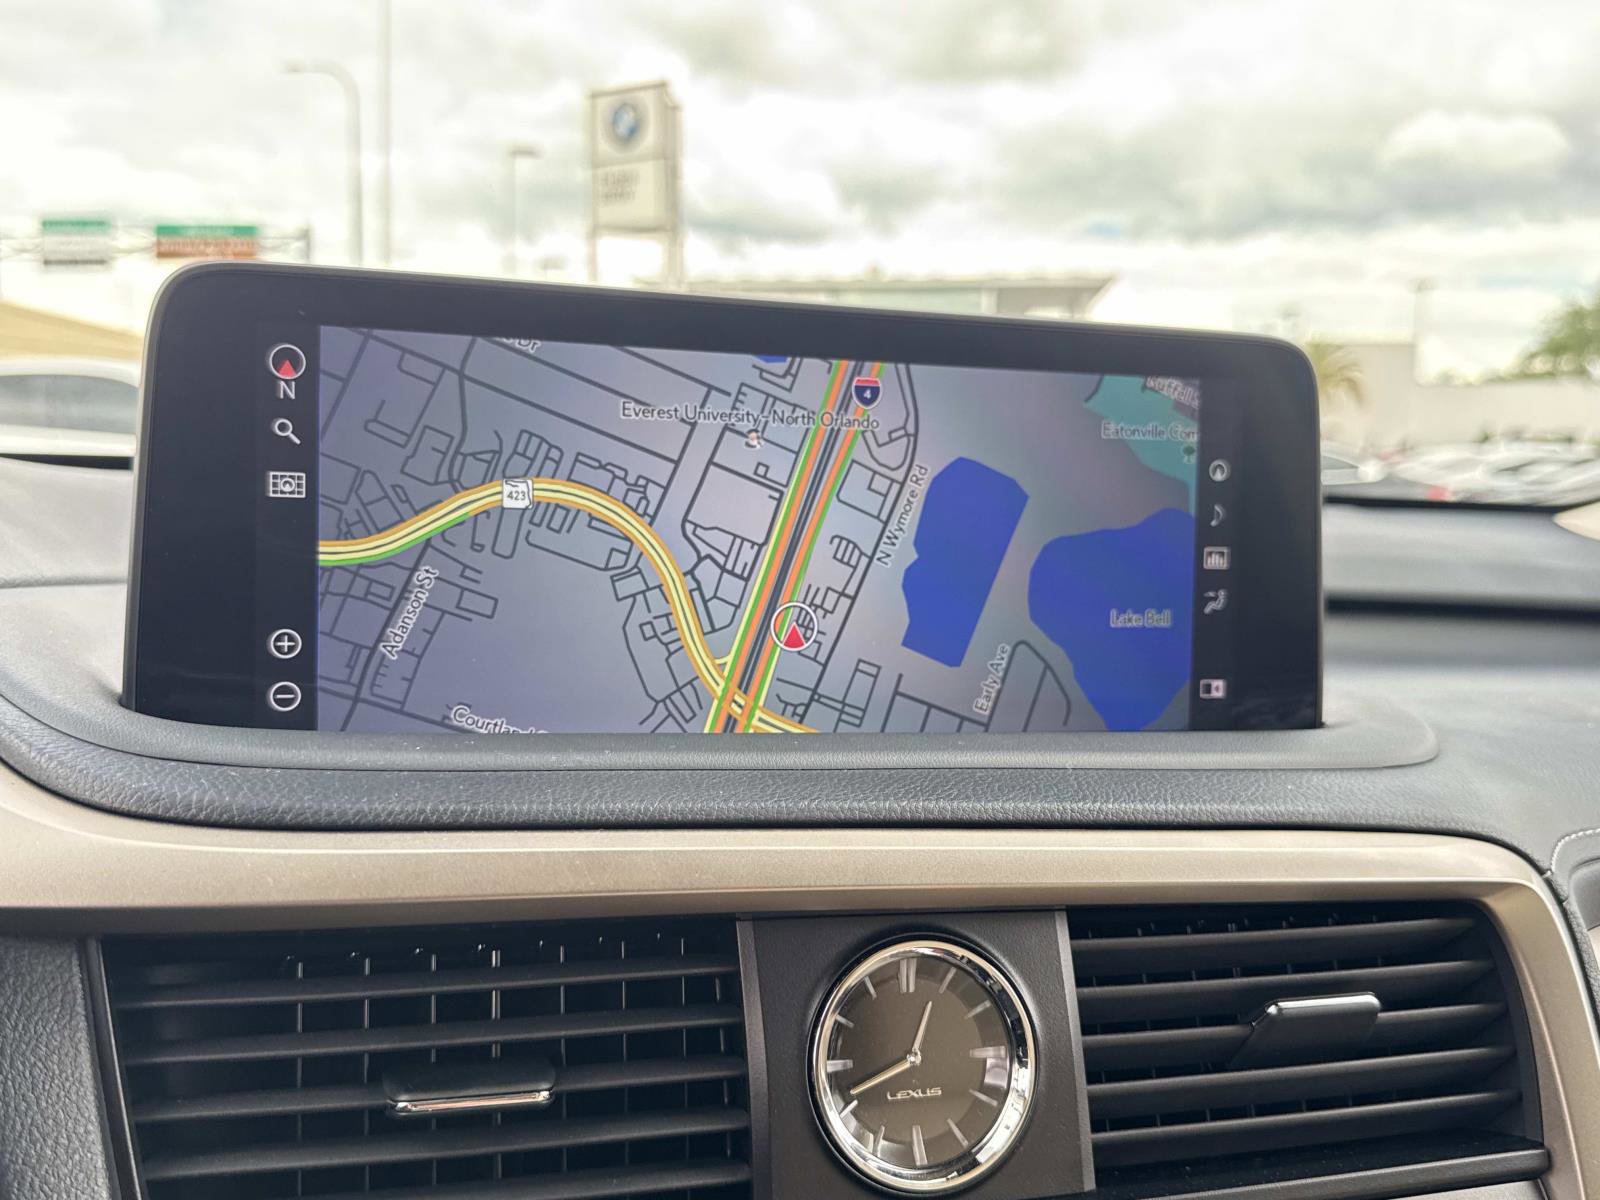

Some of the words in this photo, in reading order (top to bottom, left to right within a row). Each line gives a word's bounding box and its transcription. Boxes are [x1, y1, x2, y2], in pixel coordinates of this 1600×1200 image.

[279, 380, 296, 400] N
[863, 388, 871, 399] 4
[621, 401, 681, 420] Everest
[820, 411, 879, 429] Orlando
[1102, 420, 1167, 439] Eatonville
[909, 464, 928, 487] Rd
[507, 490, 527, 501] 423
[882, 489, 919, 547] Wymore
[876, 549, 892, 566] N
[381, 589, 427, 658] Adanson
[415, 567, 438, 588] St
[1111, 609, 1143, 628] Lake
[1144, 609, 1171, 628] Bell
[973, 676, 1000, 714] Early
[988, 644, 1009, 675] Ave
[886, 1086, 942, 1101] LEXUS
